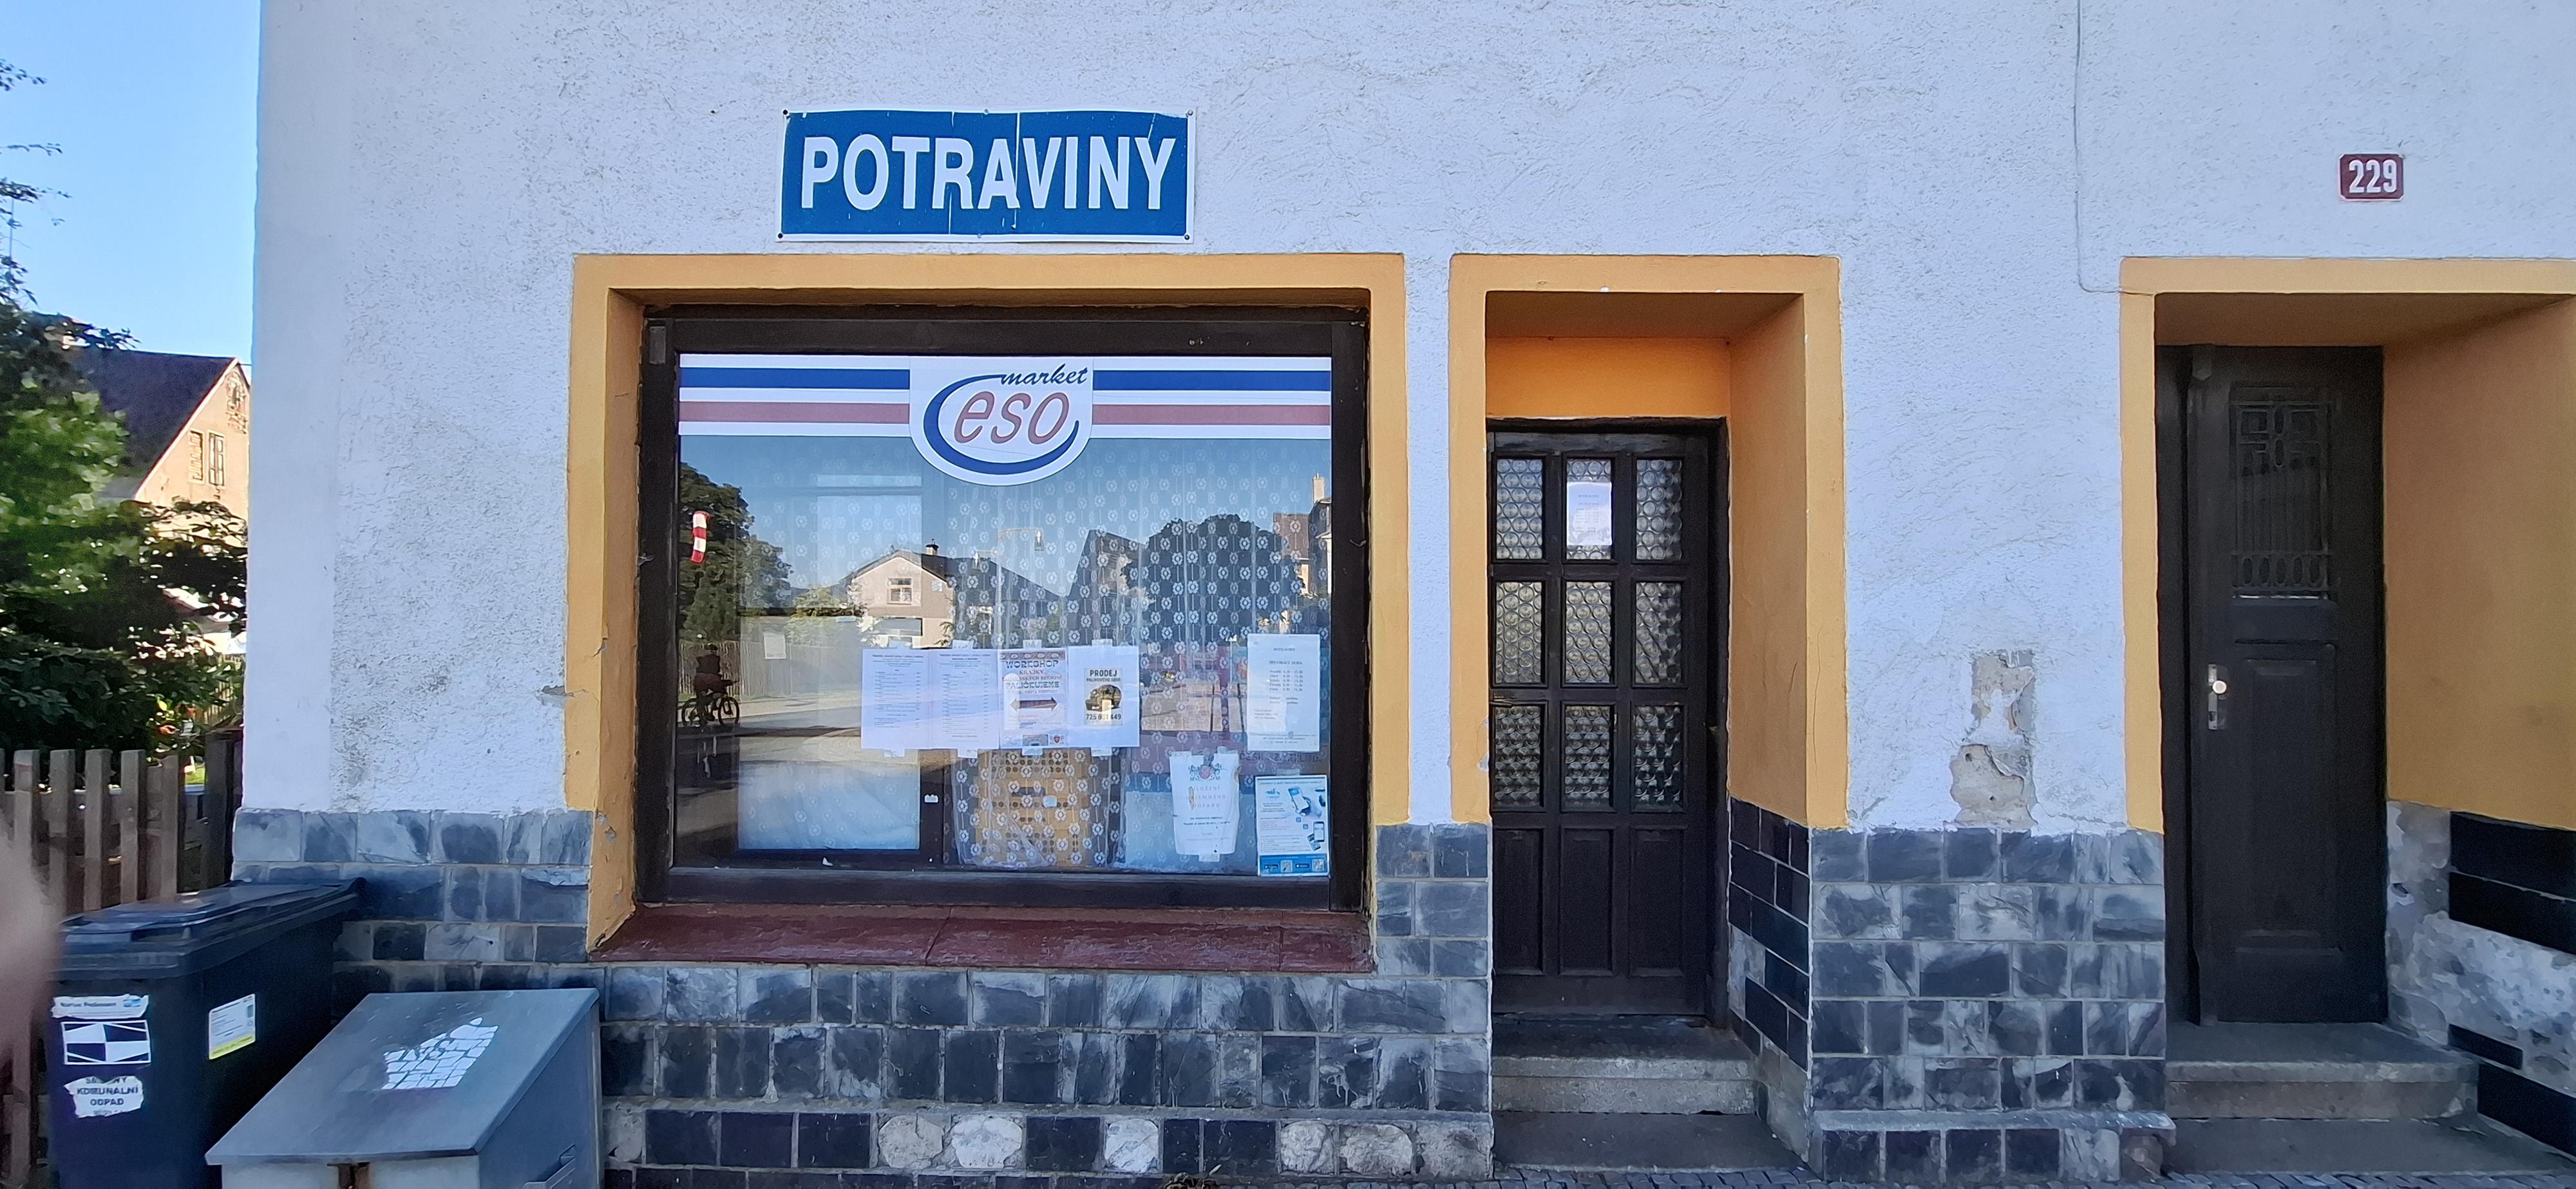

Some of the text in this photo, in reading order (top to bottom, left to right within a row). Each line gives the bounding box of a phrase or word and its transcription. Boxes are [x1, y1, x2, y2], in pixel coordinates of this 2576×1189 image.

[801, 134, 1177, 211] POTRAVINY
[2349, 159, 2397, 193] 229
[1000, 363, 1088, 386] market
[954, 391, 1070, 444] eso
[1006, 660, 1059, 668] WORKSHOP
